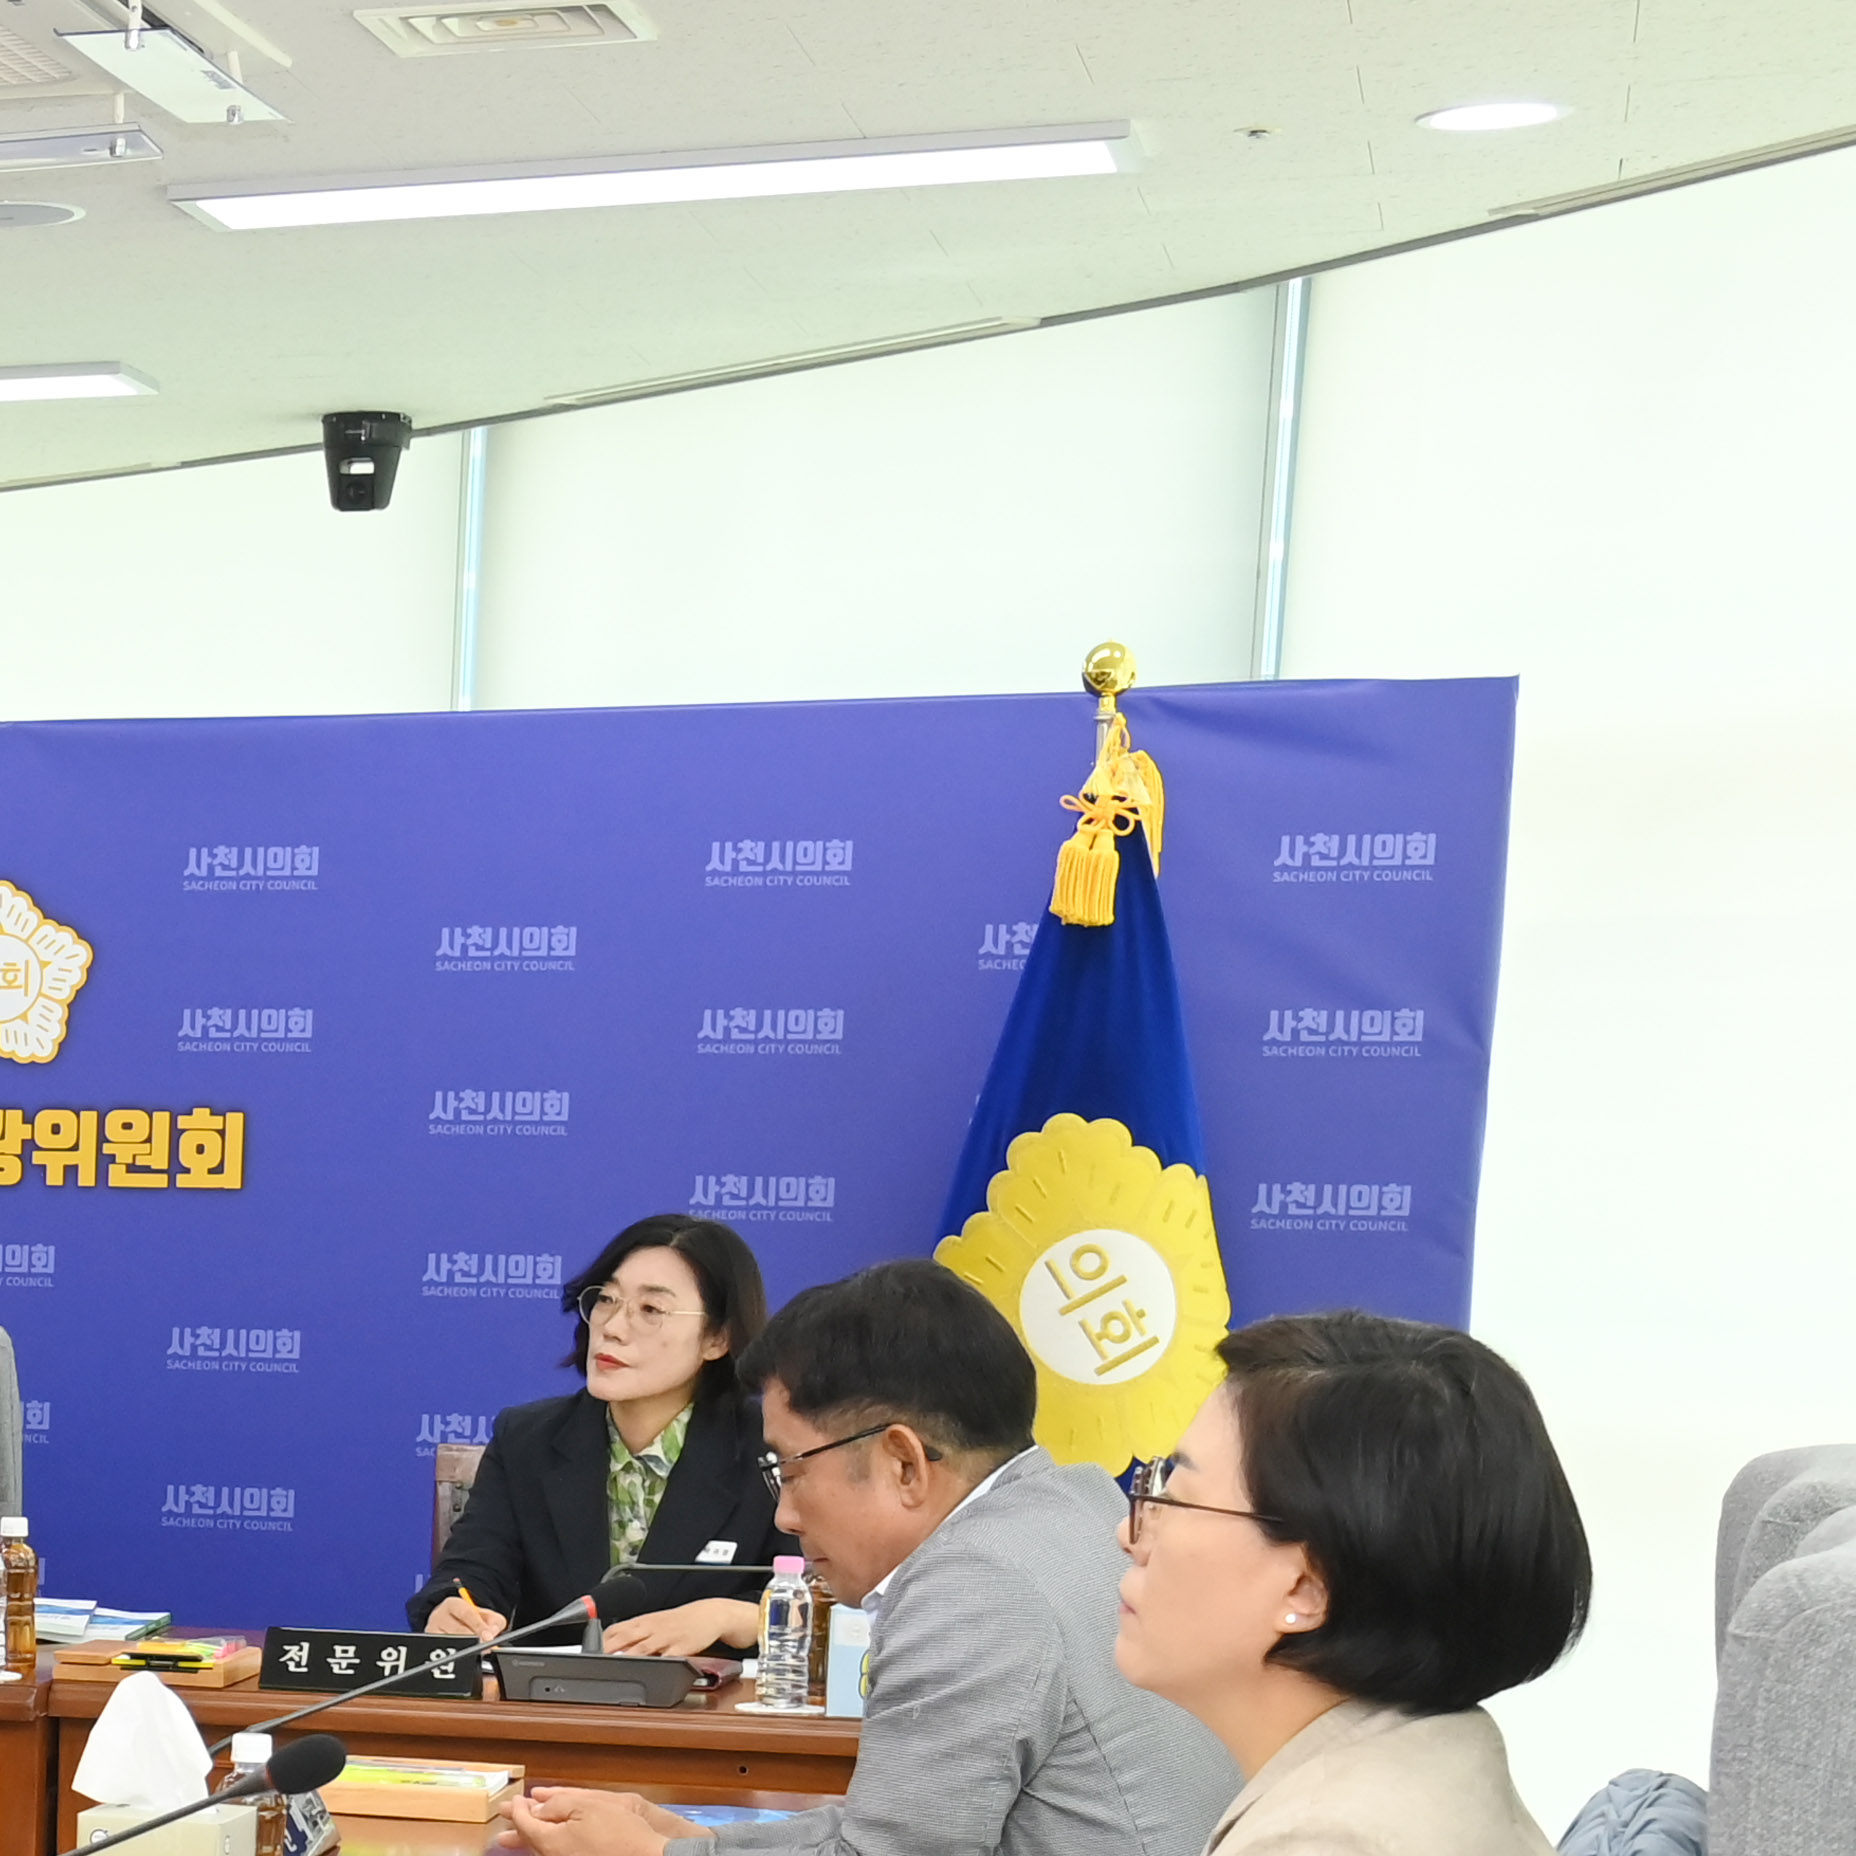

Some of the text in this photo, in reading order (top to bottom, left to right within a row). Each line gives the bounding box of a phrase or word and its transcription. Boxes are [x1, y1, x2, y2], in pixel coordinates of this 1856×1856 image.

[184, 845, 319, 877] 사천시의회
[705, 839, 853, 872] 사천시의회
[1274, 832, 1436, 867] 사천시의회
[183, 880, 318, 891] SACHEON CITY COUNCIL
[705, 876, 850, 887] SACHEON CITY COUNCIL
[1273, 870, 1433, 882] SACHEON CITY COUNCIL
[435, 925, 577, 957] 사천시의회
[435, 961, 575, 971] SACHEON CITY COUNCIL
[178, 1007, 313, 1038] 사천시의회
[697, 1007, 844, 1040] 사천시의회
[1263, 1008, 1424, 1042] 사천시의회
[178, 1042, 311, 1052] SACHEON CITY COUNCIL
[697, 1043, 841, 1054] SACHEON CITY COUNCIL
[1263, 1046, 1421, 1056] SACHEON CITY COUNCIL
[429, 1089, 569, 1121] 사천시의회
[429, 1124, 568, 1136] SACHEON CITY COUNCIL
[689, 1174, 835, 1207] 사천시의회
[1251, 1182, 1411, 1216] 사천시의회
[749, 1211, 776, 1221] CITY
[779, 1211, 832, 1222] COUNCIL
[1250, 1218, 1408, 1231] SACHEON CITY COUNCIL
[6, 1277, 53, 1287] COUNCIL
[422, 1252, 562, 1285] 사천시의회
[422, 1286, 560, 1299] SACHEON CITY COUNCIL
[1044, 1243, 1160, 1377] 의회
[167, 1326, 301, 1359] 사천시의회
[166, 1360, 299, 1373] SACHEON CITY COUNCIL
[161, 1484, 295, 1517] 사천시의회
[161, 1517, 293, 1531] SACHEON CITY COUNCIL
[279, 1641, 457, 1679] 전문위원
